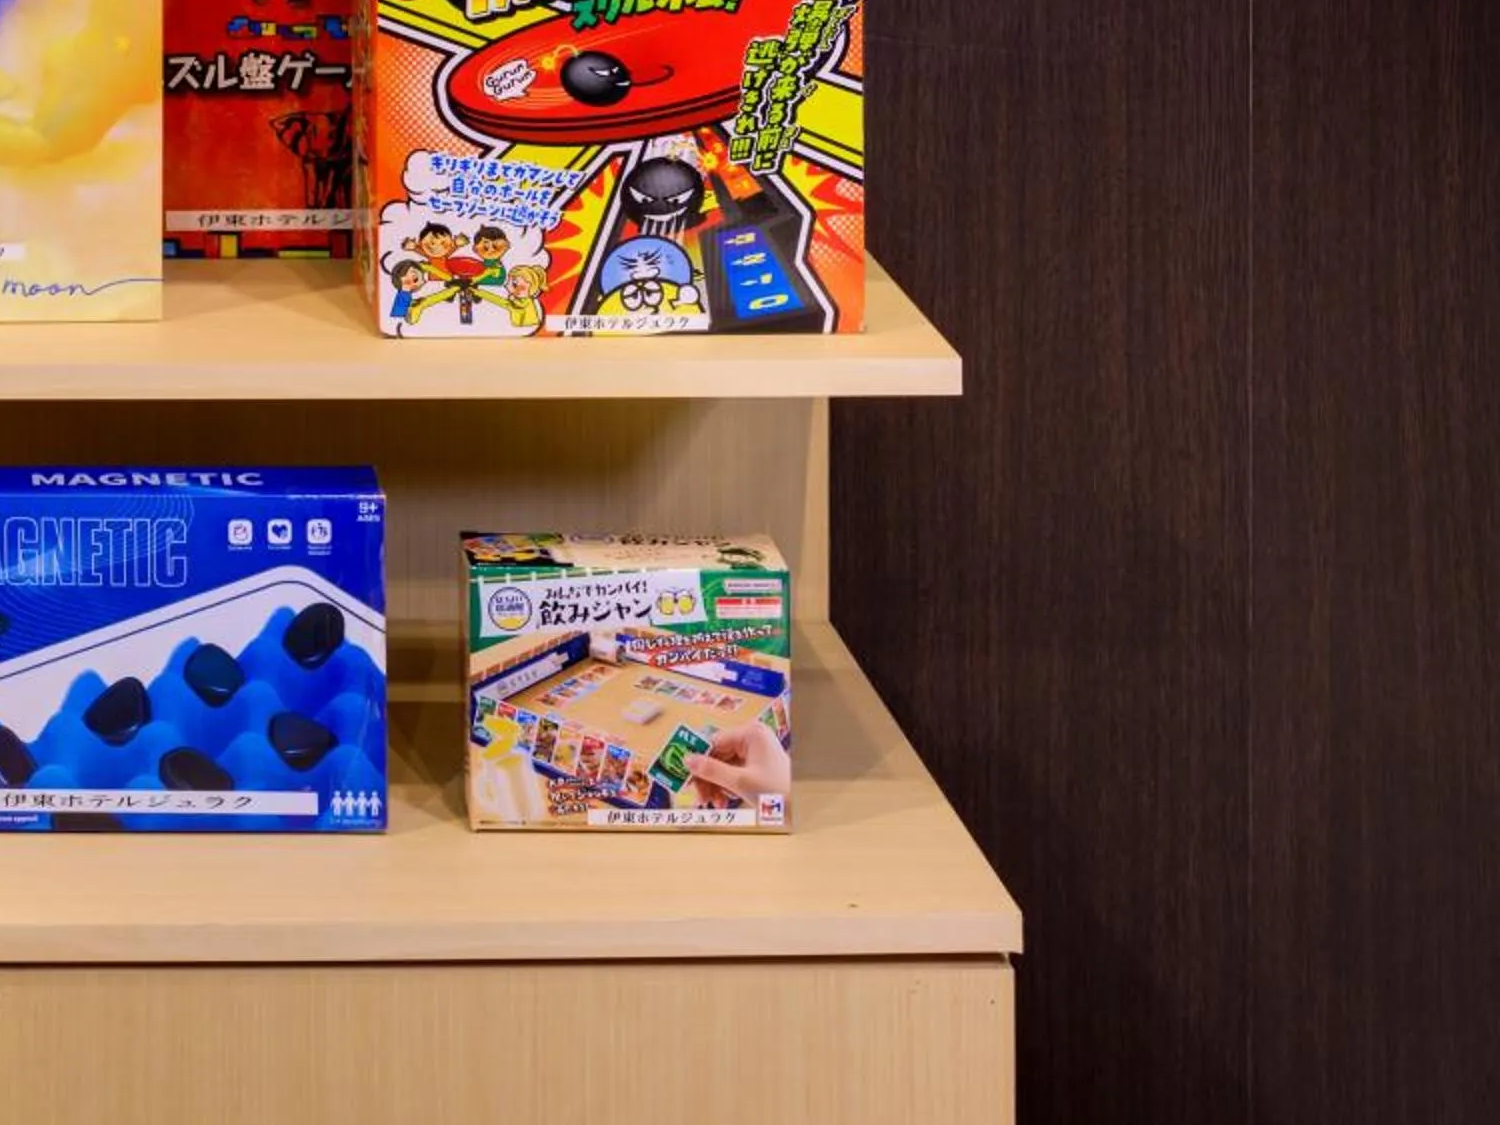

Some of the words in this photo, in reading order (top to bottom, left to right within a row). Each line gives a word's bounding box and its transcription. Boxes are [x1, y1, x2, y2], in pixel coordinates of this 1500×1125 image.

[167, 52, 353, 90] ズル盤ゲー
[430, 155, 581, 187] ギリギリまでガマンして
[198, 213, 351, 226] 伊東ホテルジ
[1, 276, 100, 296] moon
[563, 315, 691, 331] 伊東ホテルジュラク
[31, 472, 265, 487] MAGNETIC
[539, 598, 653, 625] 飲みジャン
[3, 791, 256, 809] 伊東ホテルジュラク
[607, 810, 736, 824] 伊東ホテルジュラク
